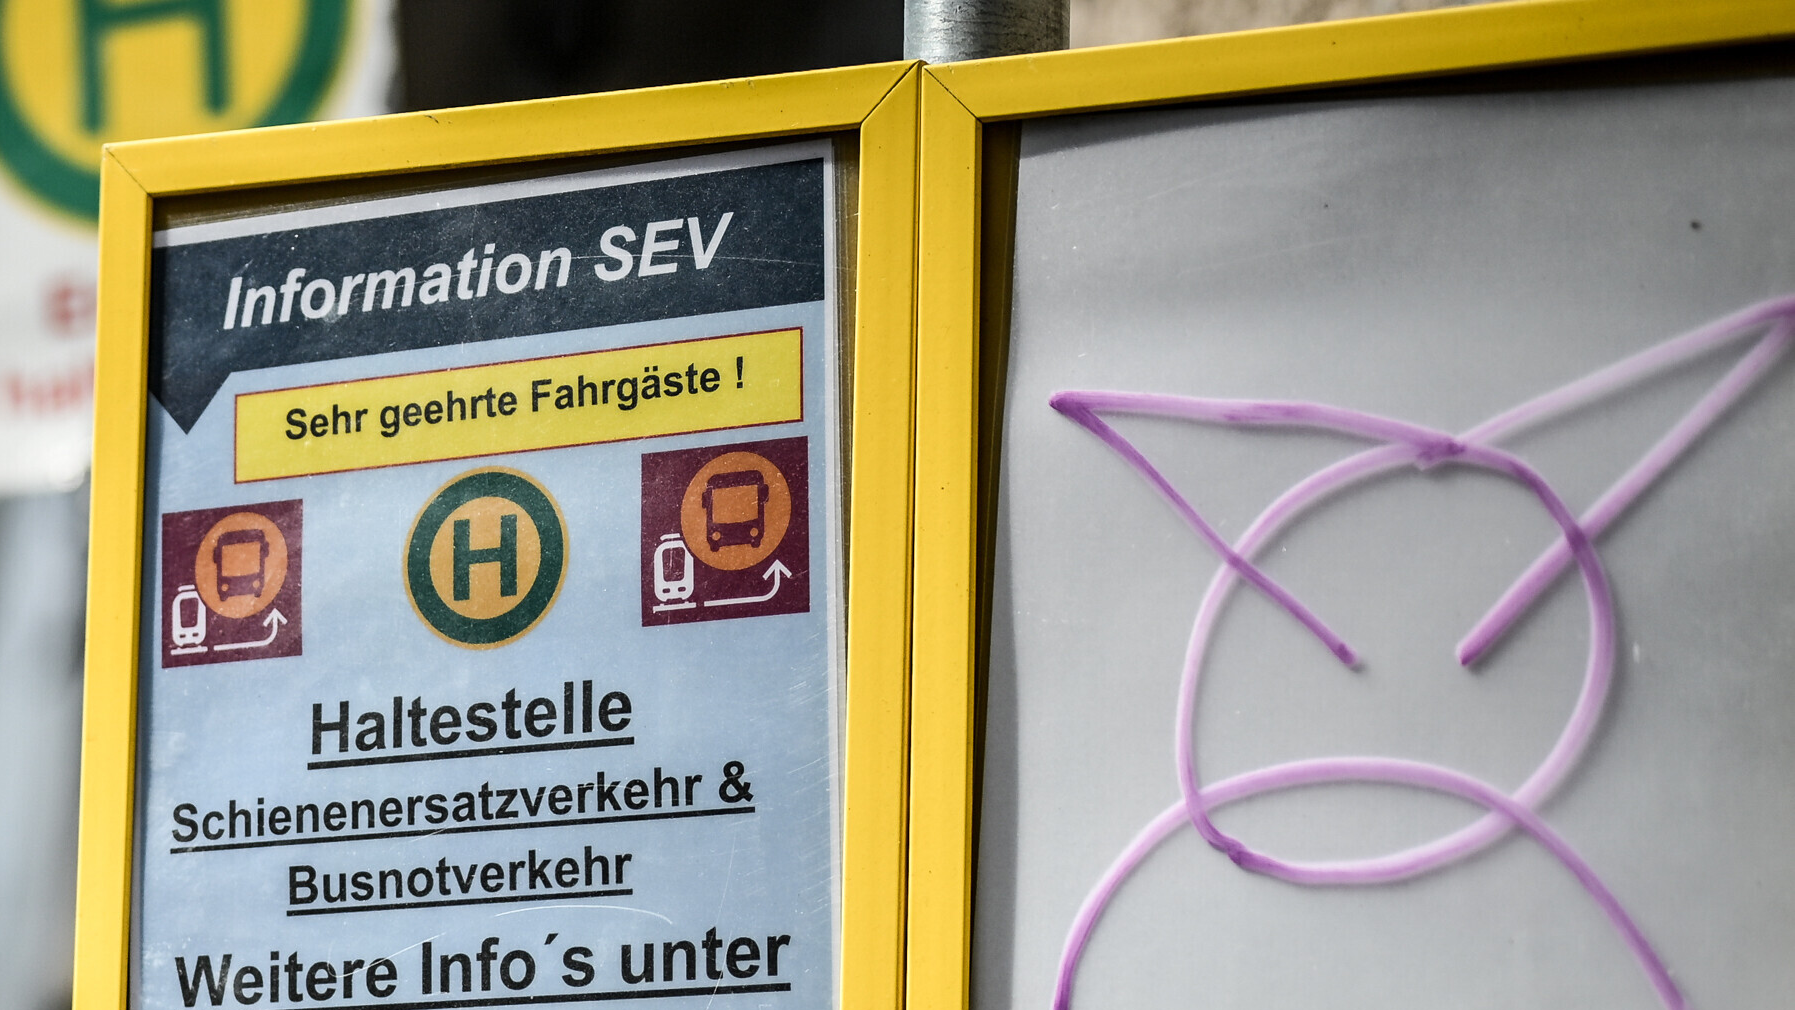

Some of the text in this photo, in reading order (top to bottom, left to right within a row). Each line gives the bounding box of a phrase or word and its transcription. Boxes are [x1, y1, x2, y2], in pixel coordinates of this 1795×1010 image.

[223, 211, 735, 331] Information SEV
[284, 356, 745, 441] Sehr geehrte Fahrgäste !
[453, 514, 517, 601] H
[310, 680, 634, 756] Haltestelle
[171, 760, 755, 842] Schienenersatzverkehr &
[287, 846, 634, 906] Busnotverkehr
[174, 952, 399, 1010] Weitere
[620, 928, 791, 985] unter
